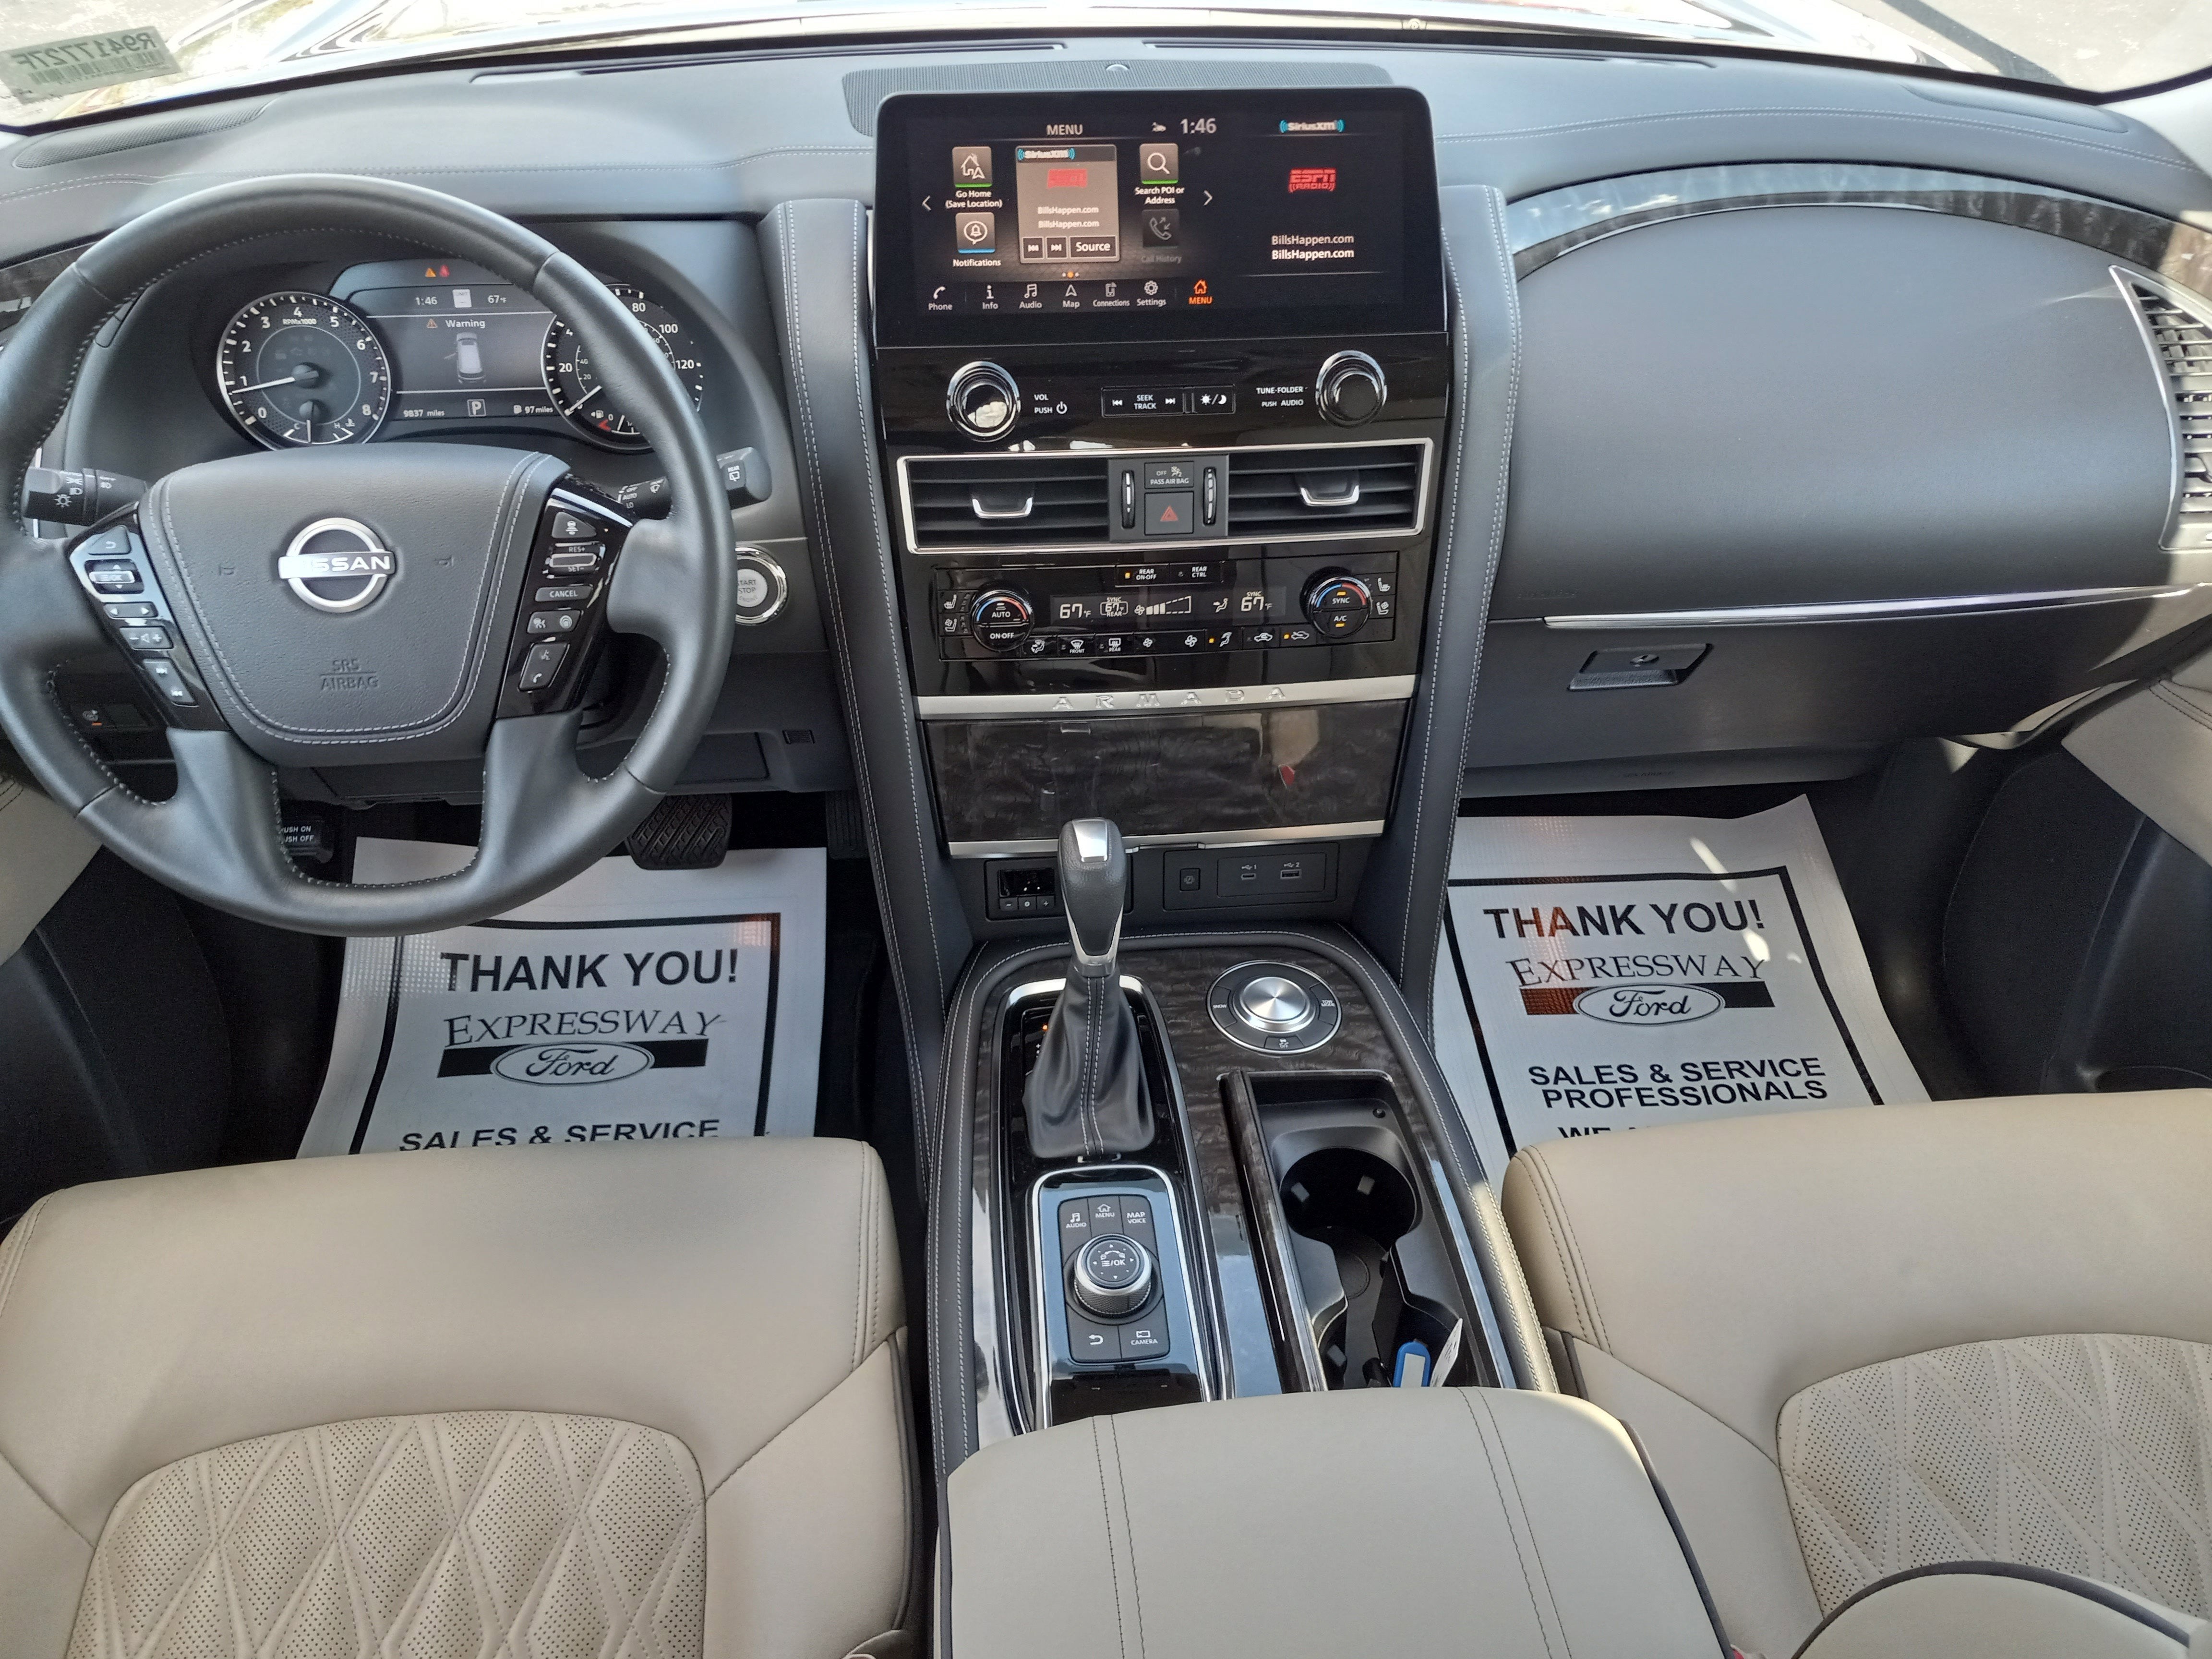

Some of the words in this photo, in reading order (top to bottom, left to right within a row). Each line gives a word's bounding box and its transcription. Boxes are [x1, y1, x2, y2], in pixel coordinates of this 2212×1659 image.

[1046, 124, 1083, 135] MENU
[1180, 118, 1217, 134] 1:46
[1288, 122, 1336, 131] SiriusXM
[1134, 187, 1161, 195] Search
[945, 200, 966, 209] (Save
[967, 199, 1003, 208] Location)
[1144, 196, 1176, 205] Address
[1037, 206, 1099, 216] BillsHappen.com
[1038, 220, 1100, 229] BillsHappen.com
[1272, 235, 1354, 246] BillsHappen.com
[1076, 241, 1111, 252] Source
[1272, 249, 1354, 261] BillsHappen.com
[952, 259, 1001, 267] Notifications
[415, 295, 438, 306] 1:46
[983, 301, 998, 310] Info
[1019, 301, 1042, 309] Audio
[1062, 301, 1080, 309] Map
[1093, 299, 1130, 307] Connections
[1137, 298, 1166, 307] Settings
[1189, 296, 1213, 304] MENU
[293, 306, 302, 318] 4
[631, 302, 646, 313] 80
[928, 302, 953, 311] Phone
[261, 316, 271, 329] 3
[330, 315, 339, 328] 5
[445, 318, 486, 329] Warning
[659, 324, 679, 334] 100
[242, 339, 252, 353] 2
[357, 338, 366, 351] 6
[559, 362, 573, 373] 20
[675, 359, 695, 370] 120
[240, 375, 248, 387] 1
[369, 371, 379, 384] 7
[257, 406, 267, 419] 0
[362, 404, 372, 416] 8
[403, 409, 424, 418] 9837
[427, 408, 445, 417] miles
[470, 401, 482, 415] P
[525, 406, 535, 414] 97
[535, 406, 553, 414] miles
[549, 589, 578, 598] CANCEL
[1334, 614, 1347, 623] A/C
[332, 658, 361, 672] SRS
[320, 676, 379, 690] AIRBAG
[1052, 686, 1286, 710] ARMADA
[300, 834, 314, 842] OFF
[1483, 903, 1646, 939] THANK
[1649, 899, 1765, 934] YOU!
[440, 952, 609, 993] THANK
[623, 948, 739, 988] YOU!
[1506, 954, 1766, 987] EXPRESSWAY
[1608, 989, 1692, 1018] Ford
[444, 1009, 727, 1049] EXPRESSWAY
[526, 1047, 619, 1077] Ford
[1528, 1063, 1639, 1086] SALES
[1650, 1063, 1673, 1084] &
[1680, 1057, 1827, 1082] SERVICE
[1541, 1080, 1828, 1109] PROFESSIONALS
[398, 1127, 518, 1151] SALES
[529, 1125, 552, 1144] &
[564, 1119, 721, 1142] SERVICE
